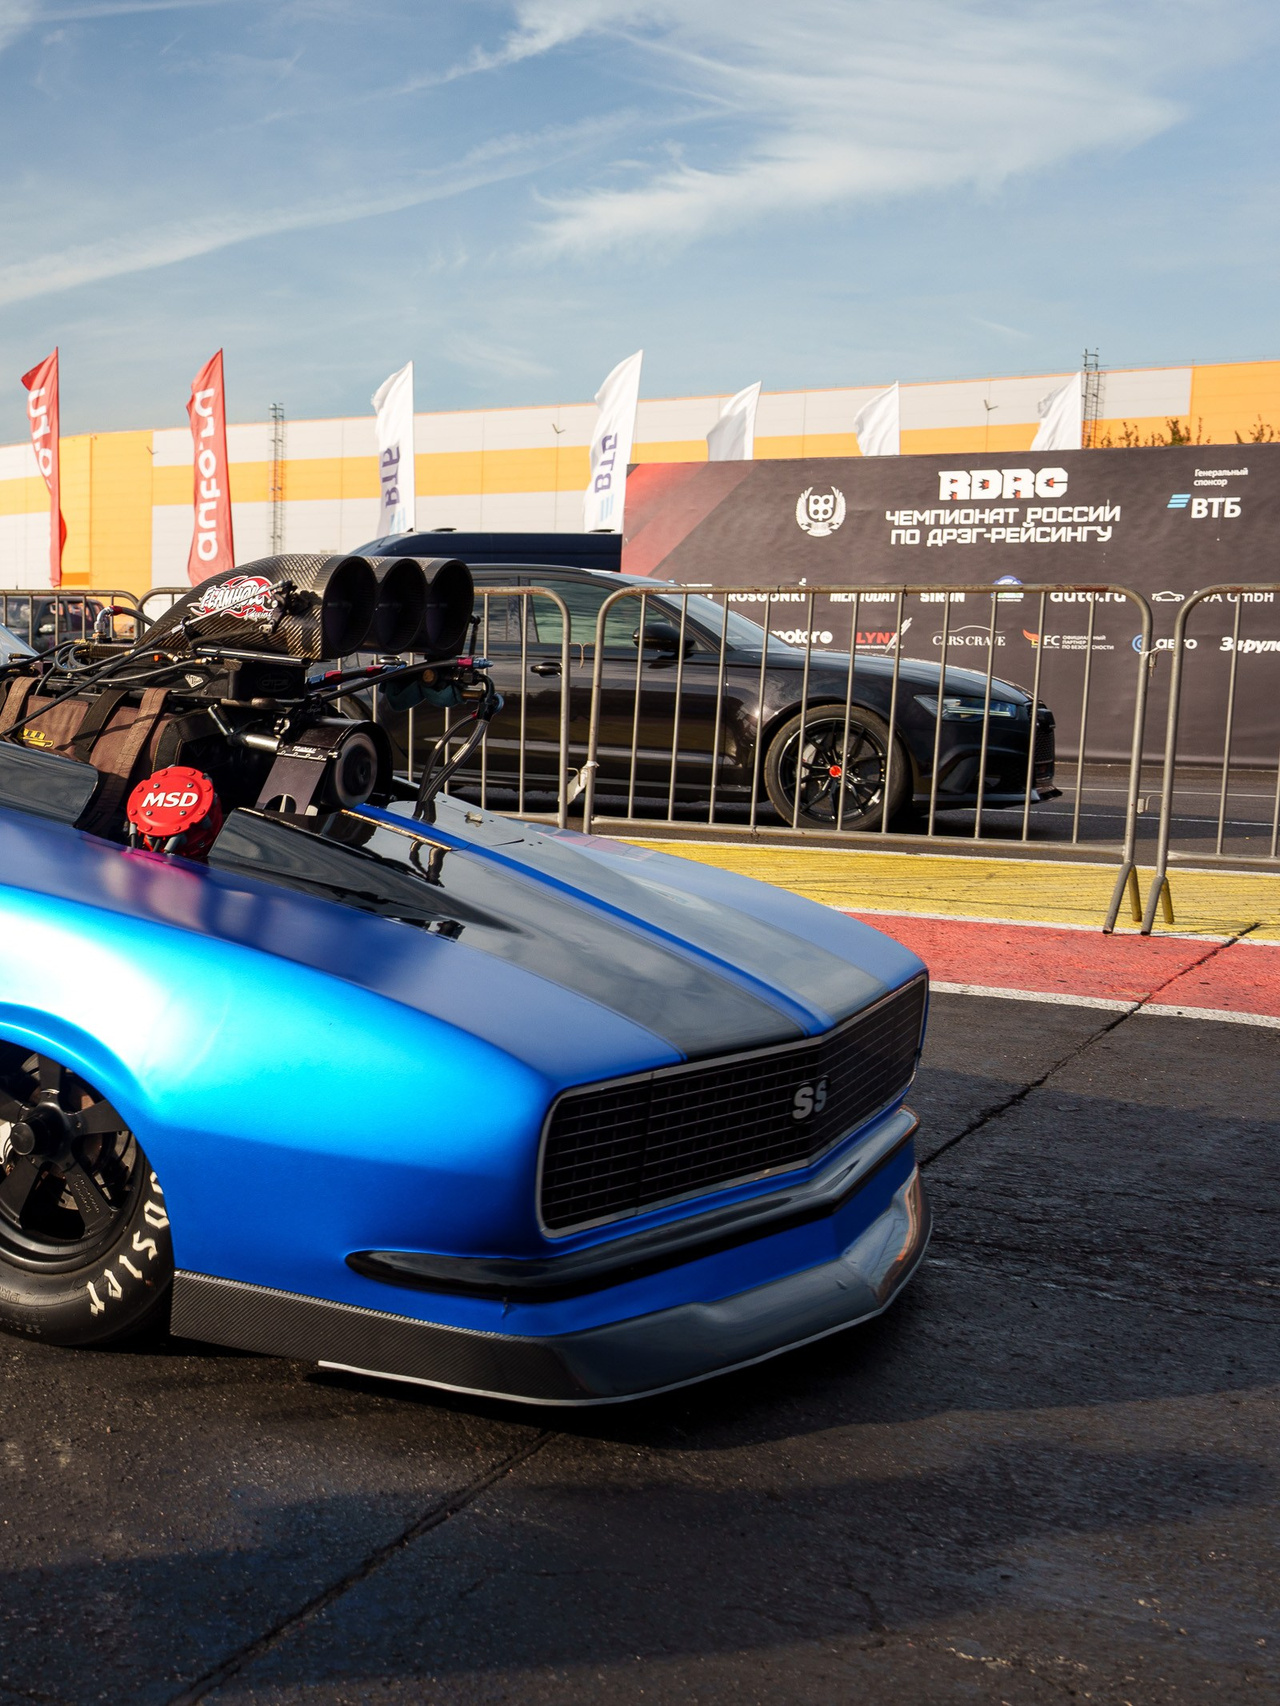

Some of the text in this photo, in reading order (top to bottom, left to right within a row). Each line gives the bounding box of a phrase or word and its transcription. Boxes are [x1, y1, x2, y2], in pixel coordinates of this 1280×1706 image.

[1193, 479, 1228, 487] спонсор
[1194, 468, 1249, 478] Генеральный
[938, 467, 1069, 501] RDRC
[885, 505, 1121, 526] ЧЕМПИОНАТ РОССИИ
[1191, 497, 1242, 519] ВТБ
[890, 521, 1112, 547] ПО ДРЭГ-РЕЙСИНГУ
[141, 792, 199, 808] MSD
[792, 1078, 827, 1119] SS
